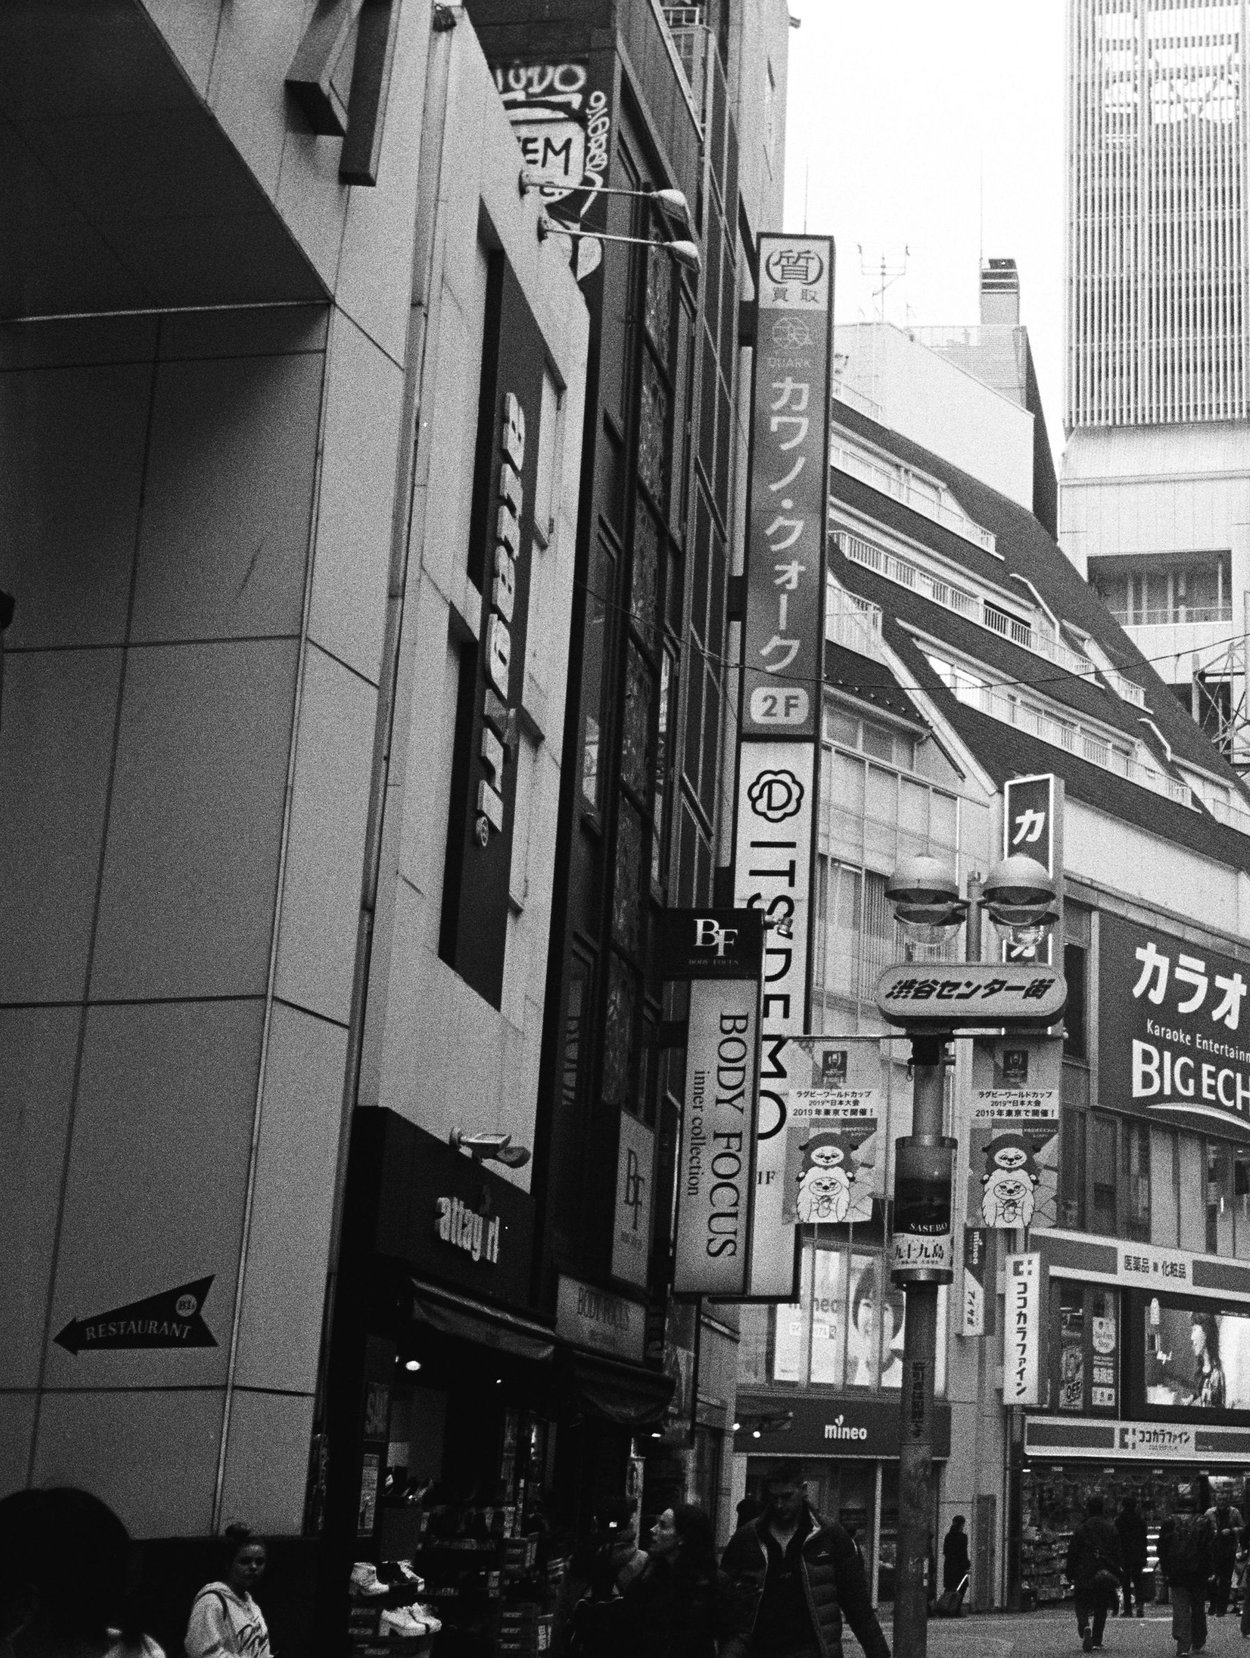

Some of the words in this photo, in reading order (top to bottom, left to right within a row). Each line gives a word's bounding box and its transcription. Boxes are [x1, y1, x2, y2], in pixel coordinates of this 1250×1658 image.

[759, 376, 810, 674] カワノ・クォーク
[761, 694, 800, 719] 2F
[884, 978, 1056, 1001] 渋谷センター街
[1146, 1019, 1192, 1047] Karaoke
[715, 1011, 750, 1114] BODY
[1132, 1038, 1195, 1099] BIG
[692, 1069, 710, 1115] inner
[686, 1116, 708, 1197] collection
[705, 1130, 745, 1259] FOCUS
[908, 1221, 949, 1234] SASEBO
[973, 1231, 981, 1265] mineo
[85, 1317, 193, 1342] RESTAURANT
[1016, 1282, 1028, 1397] ココカラファイン
[824, 1414, 868, 1441] mineo
[1138, 1429, 1191, 1444] ココカラファイン
